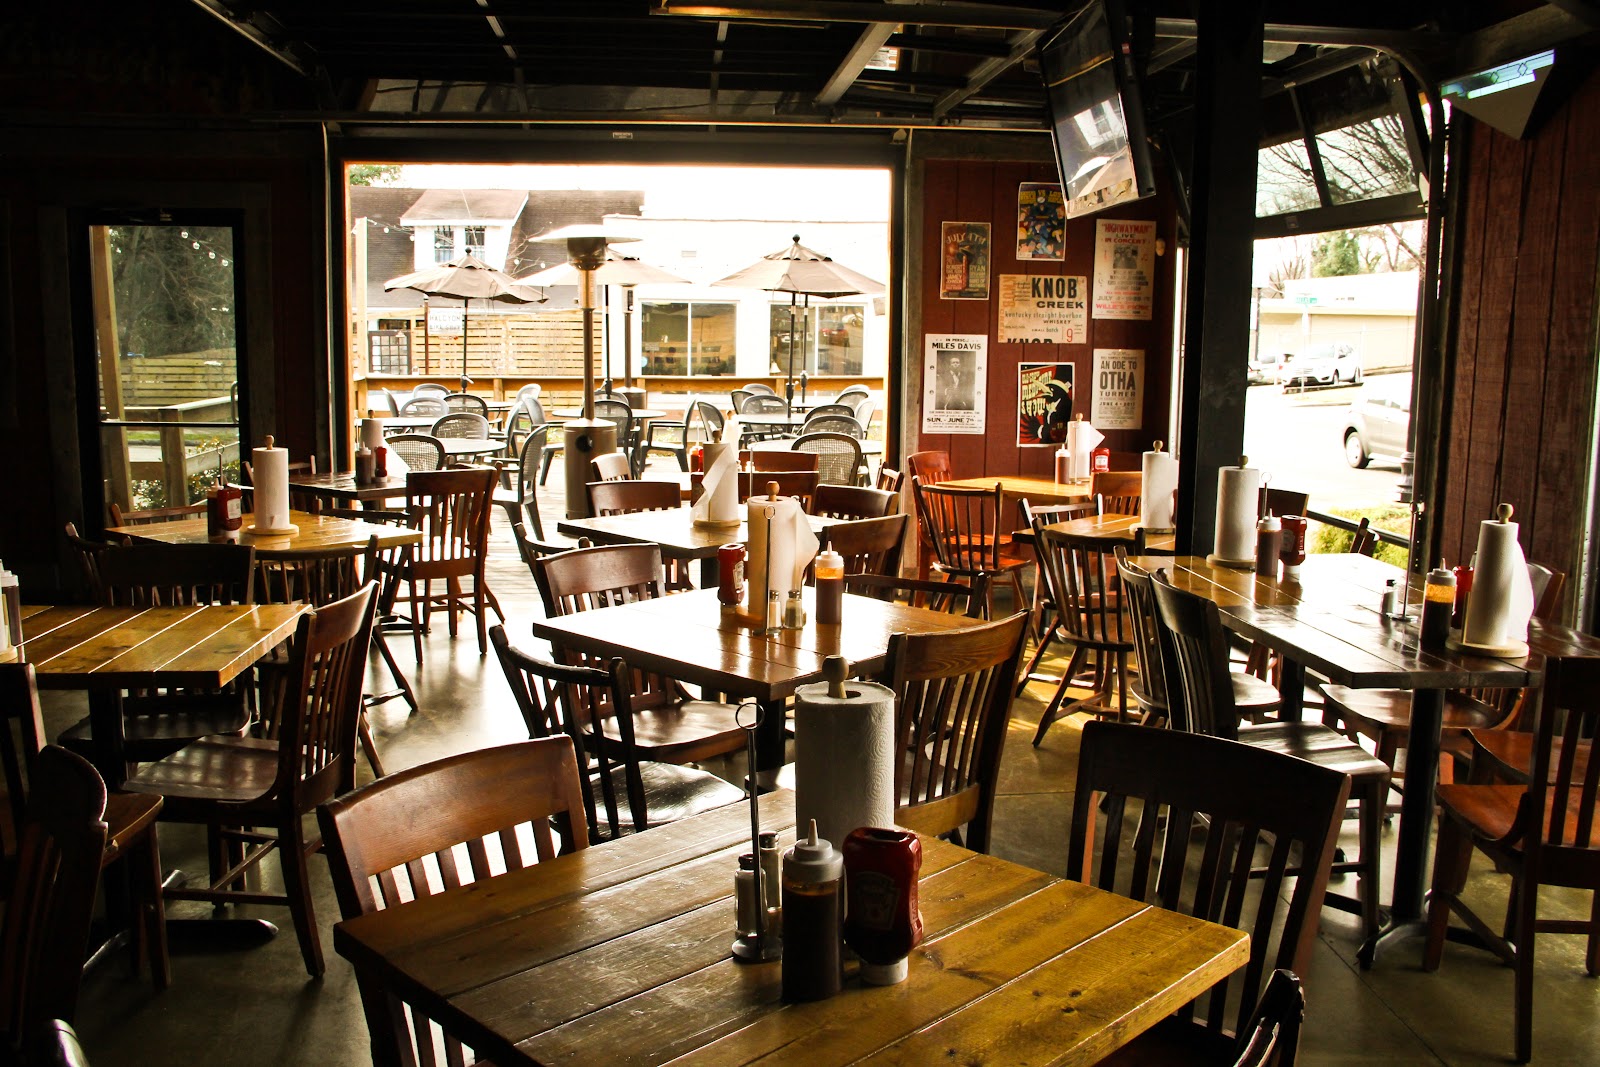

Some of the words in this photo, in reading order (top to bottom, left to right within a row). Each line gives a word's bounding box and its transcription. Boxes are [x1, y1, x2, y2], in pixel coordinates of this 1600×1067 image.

[946, 232, 966, 244] JULY
[1032, 278, 1077, 298] KNOB
[1067, 328, 1073, 342] 9
[1101, 361, 1110, 370] AN
[1112, 361, 1126, 369] ODE
[1128, 361, 1137, 370] TO
[1099, 372, 1136, 390] OTHA
